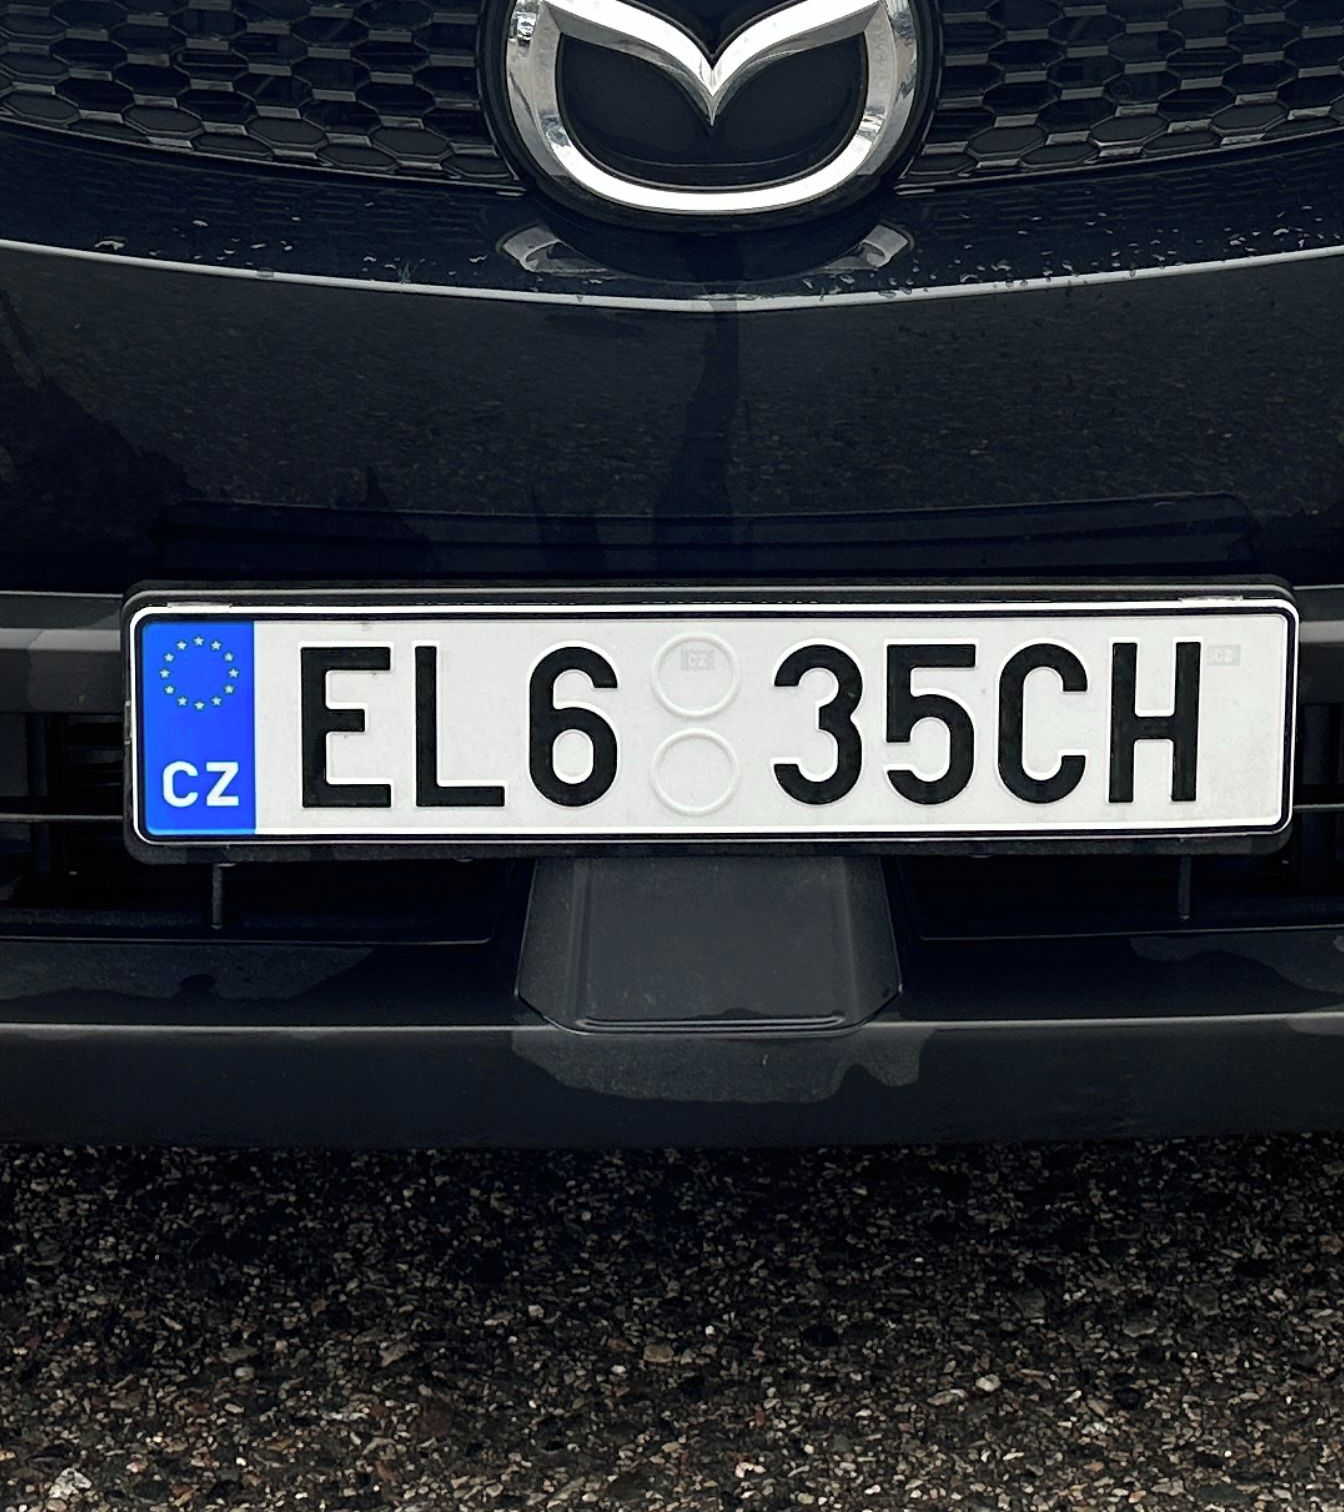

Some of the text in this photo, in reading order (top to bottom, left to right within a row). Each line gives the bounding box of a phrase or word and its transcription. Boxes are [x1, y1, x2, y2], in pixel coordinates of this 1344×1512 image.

[300, 641, 1202, 807] EL6 35CH
[162, 760, 240, 807] CZ
